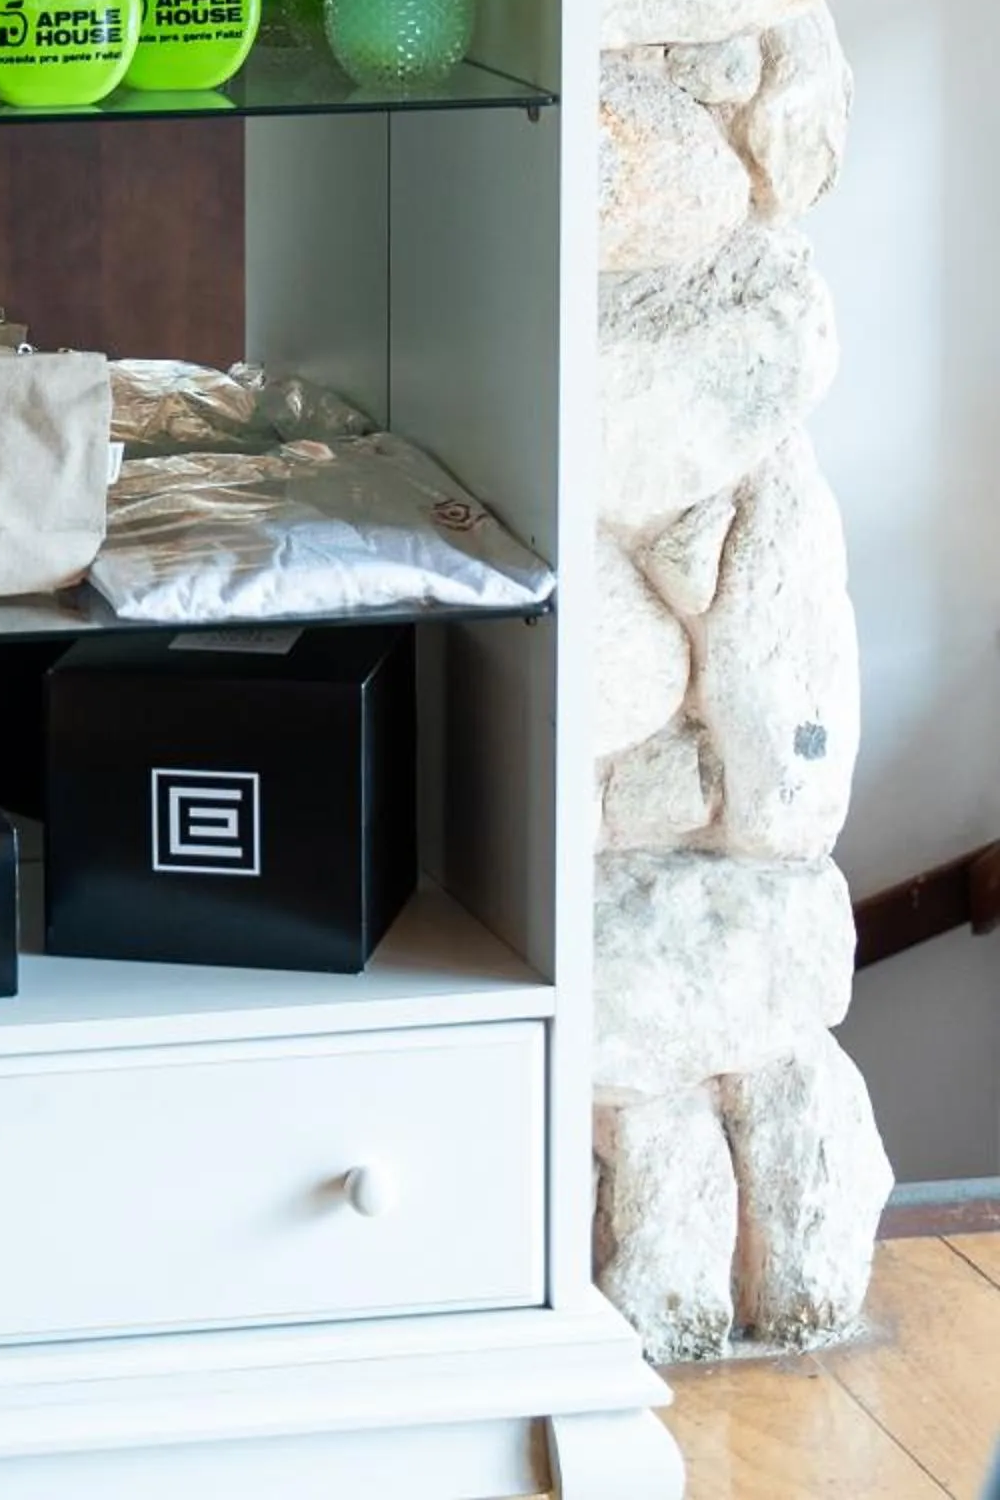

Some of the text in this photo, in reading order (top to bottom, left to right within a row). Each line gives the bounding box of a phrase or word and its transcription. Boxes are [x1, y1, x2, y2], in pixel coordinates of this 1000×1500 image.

[36, 8, 122, 27] APPLE
[155, 7, 242, 26] HOUSE
[35, 27, 122, 46] HOUSE
